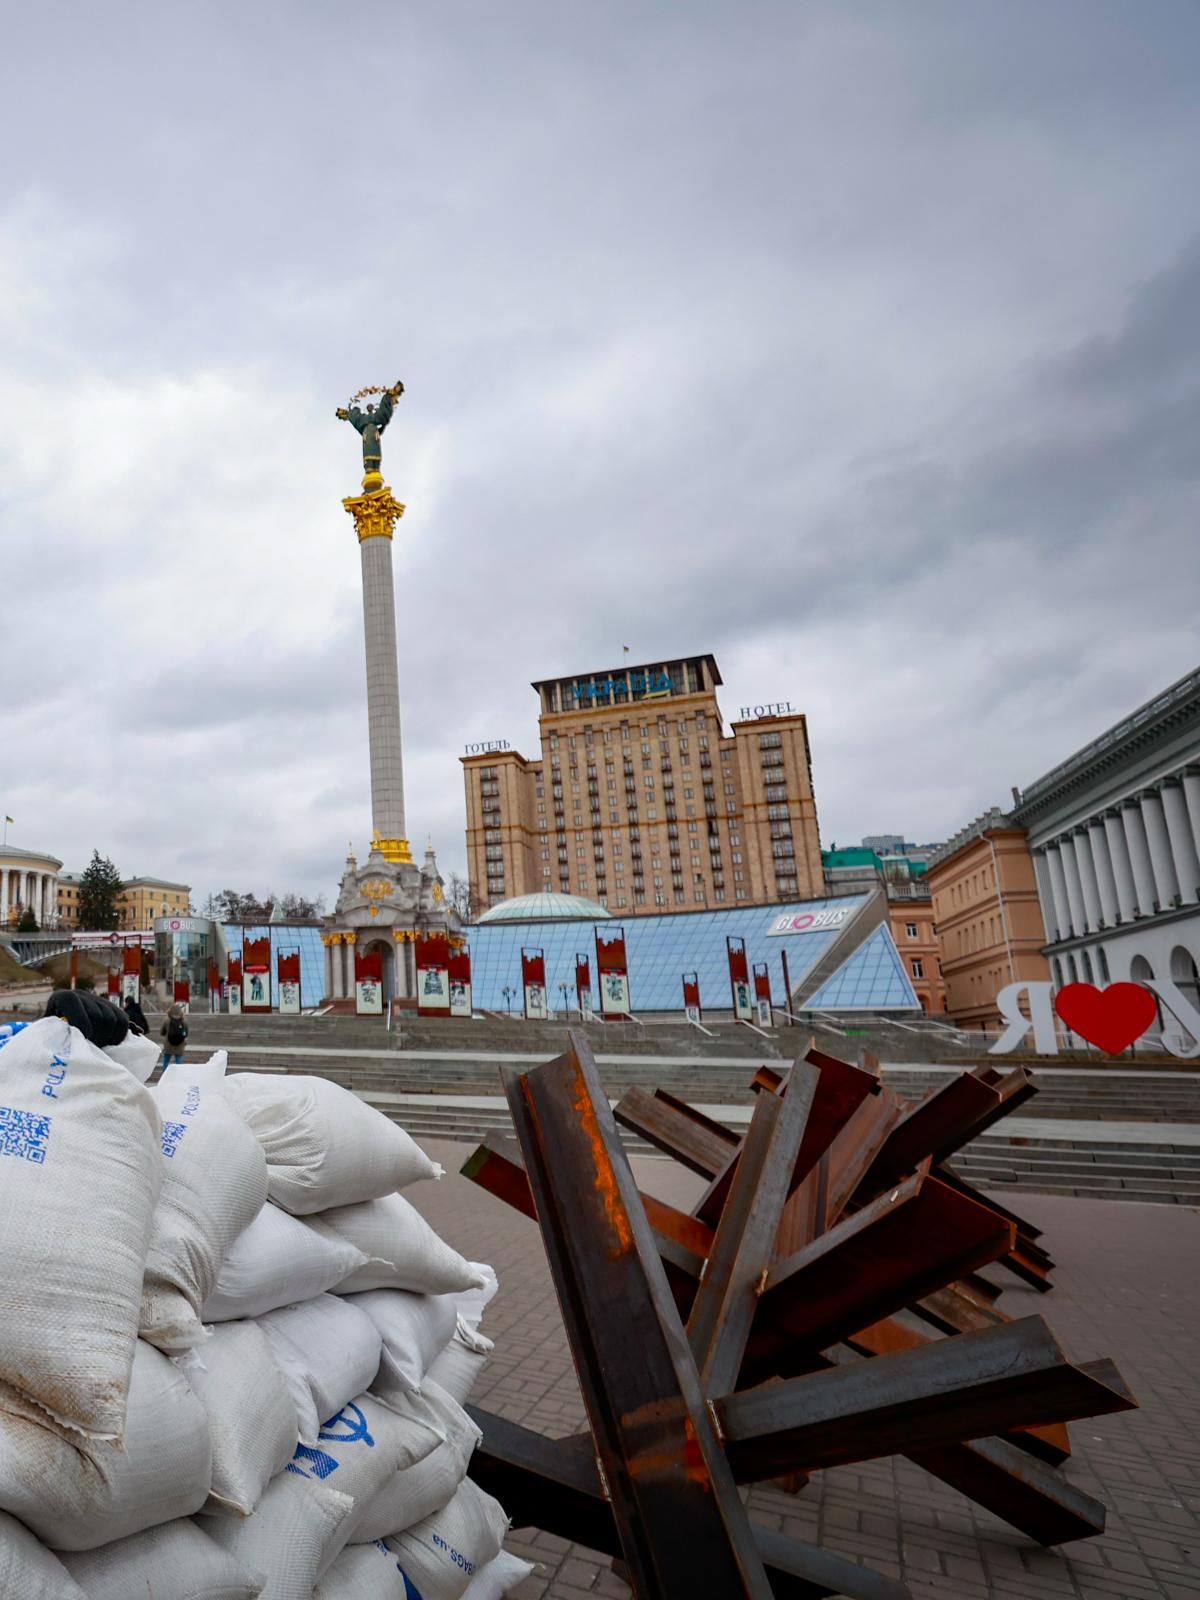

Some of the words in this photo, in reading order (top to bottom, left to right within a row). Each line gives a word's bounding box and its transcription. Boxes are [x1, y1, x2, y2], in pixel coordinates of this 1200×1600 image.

[740, 702, 796, 718] HOTEL
[464, 740, 511, 754] ГОТЕЛЬ
[163, 920, 195, 931] GLOBUS
[776, 908, 848, 930] GLOBUS
[433, 1534, 476, 1576] BAGS.ua
